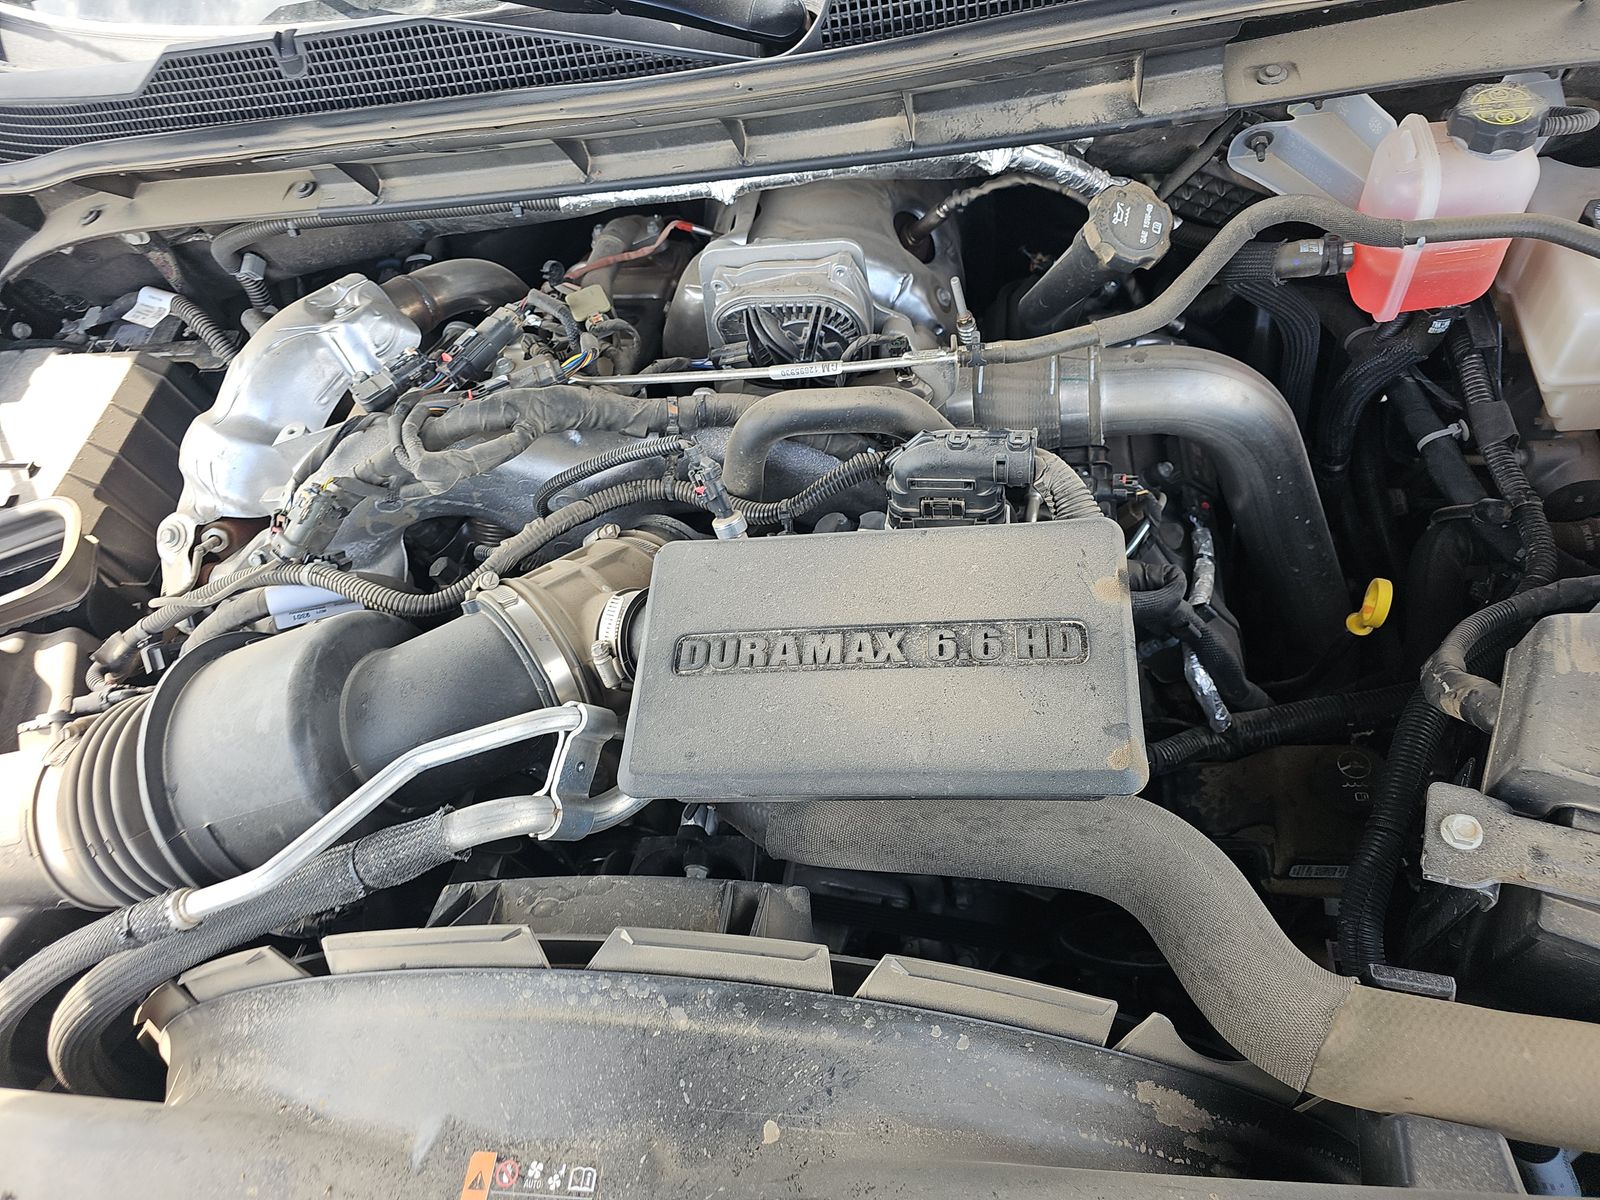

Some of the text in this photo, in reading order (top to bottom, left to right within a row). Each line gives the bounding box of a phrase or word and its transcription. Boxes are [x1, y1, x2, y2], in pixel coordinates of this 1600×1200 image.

[1140, 230, 1148, 244] SAE
[822, 363, 838, 373] GM
[682, 626, 1080, 669] DURAMAX 6.6 HD
[523, 1179, 541, 1189] AUTO
